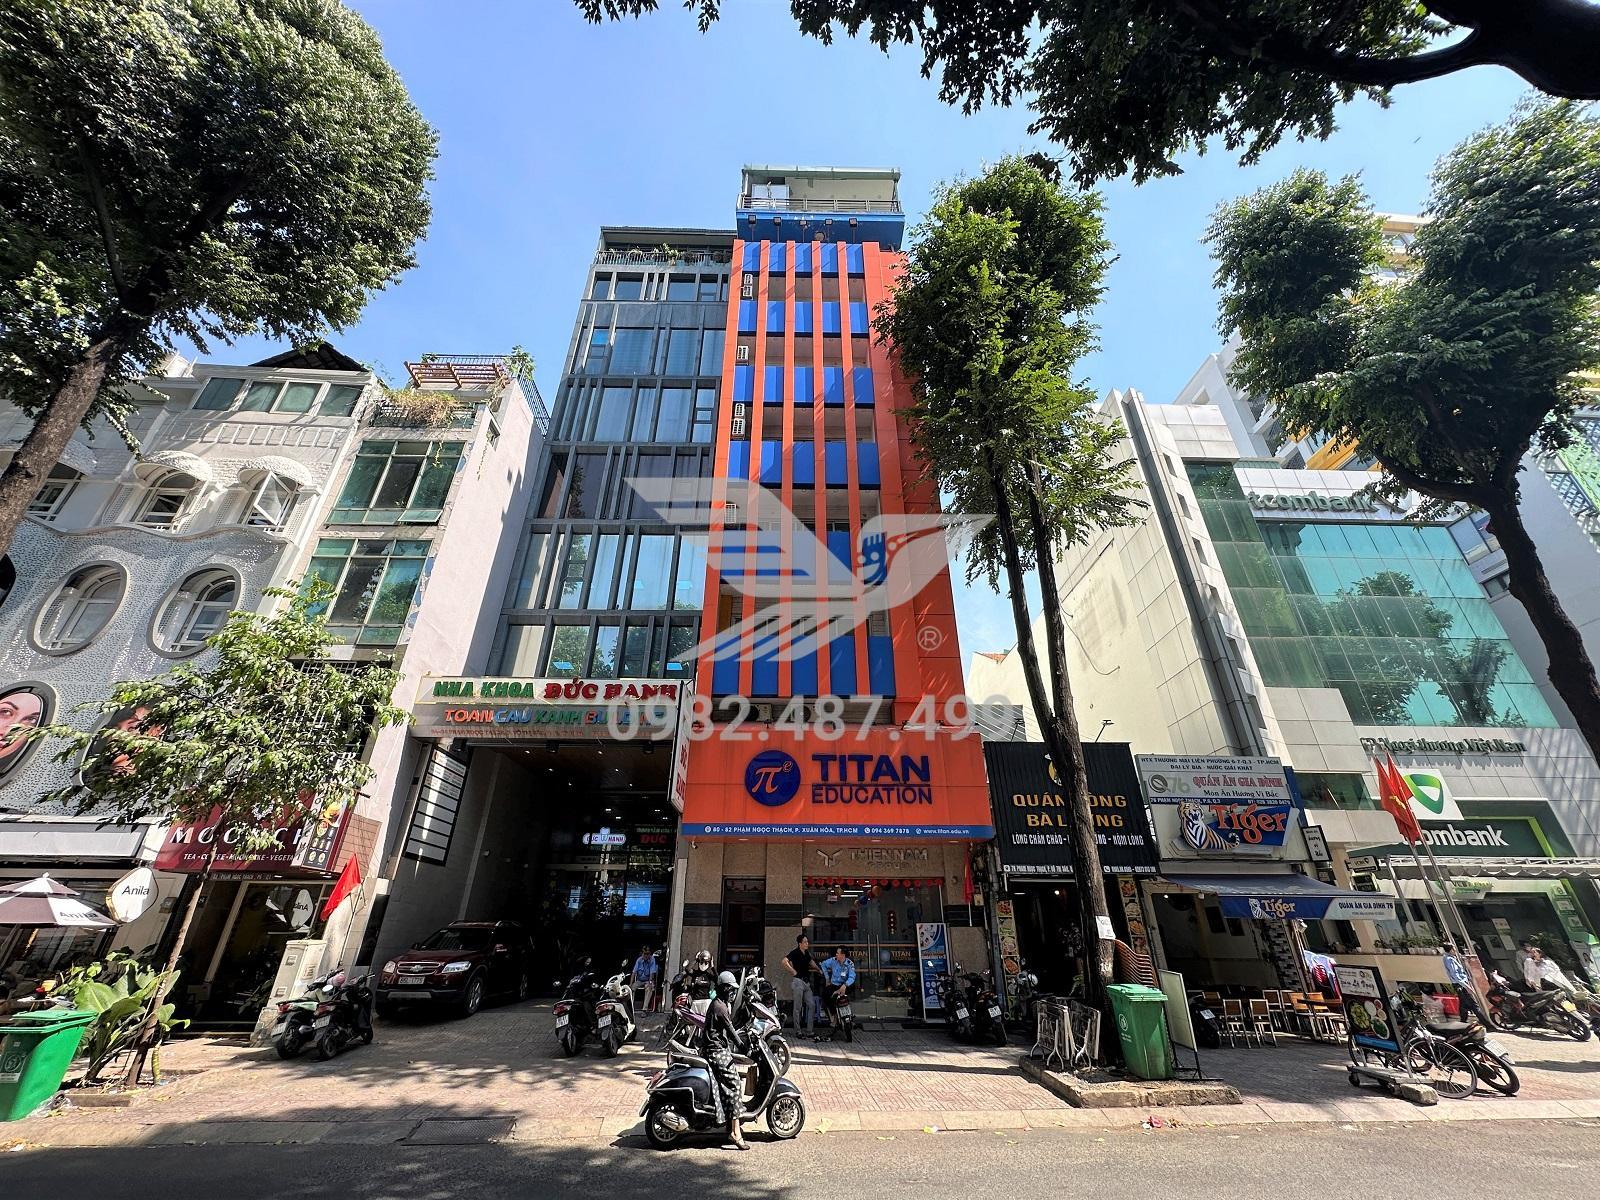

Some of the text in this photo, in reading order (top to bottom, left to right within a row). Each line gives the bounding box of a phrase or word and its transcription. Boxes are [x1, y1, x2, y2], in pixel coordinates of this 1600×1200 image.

[433, 681, 535, 698] NHA KHOA
[543, 676, 599, 699] ĐỨC
[812, 755, 930, 782] TITAN
[1192, 775, 1221, 788] QUÁN
[811, 785, 932, 804] EDUCATION
[1012, 791, 1127, 807] QUÁN ÒNG
[1026, 811, 1123, 827] BÀ LNG
[1209, 803, 1287, 844] Tiger
[734, 826, 751, 834] PHẠM
[752, 826, 771, 835] NGỌC
[183, 853, 196, 861] TEA
[200, 854, 229, 862] COFEE
[121, 885, 150, 896] Anila
[59, 911, 98, 919] Anila
[1261, 898, 1295, 917] Tiger
